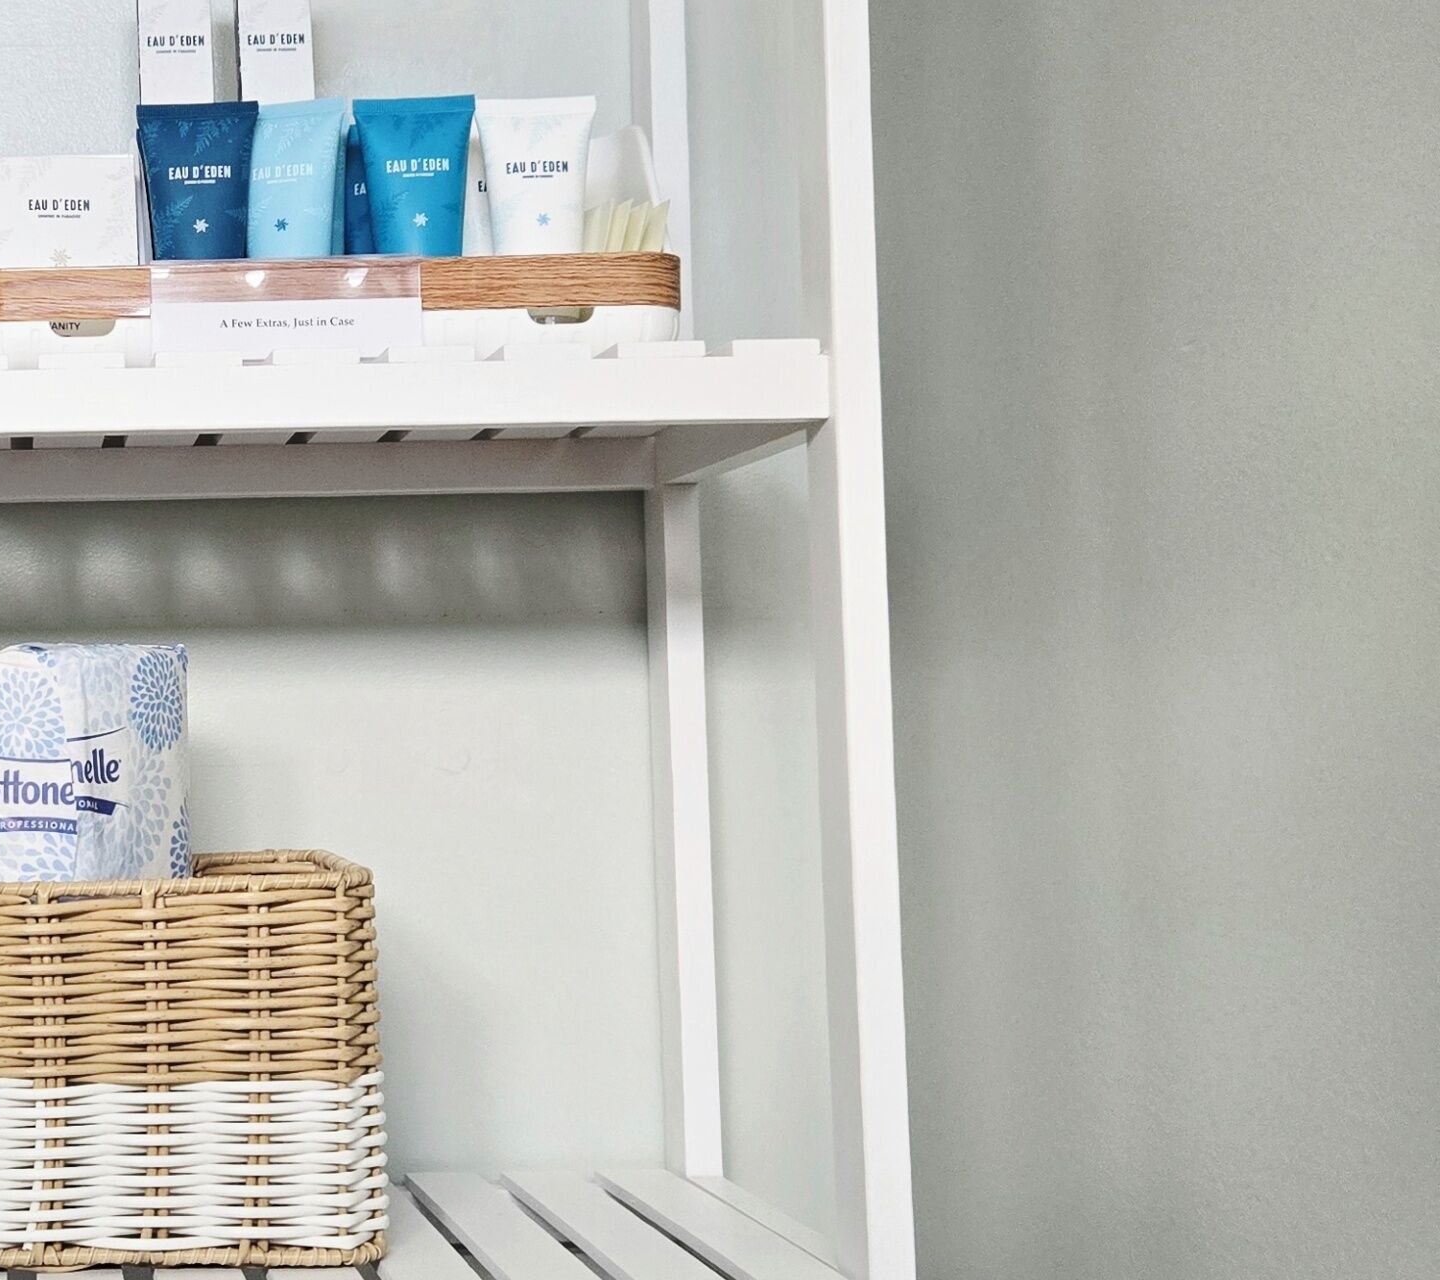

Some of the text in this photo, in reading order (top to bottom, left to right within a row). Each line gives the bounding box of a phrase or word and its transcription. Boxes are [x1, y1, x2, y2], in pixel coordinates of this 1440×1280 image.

[147, 35, 165, 47] EAU
[247, 34, 266, 46] EAU
[386, 159, 407, 173] EAU
[506, 162, 526, 174] EAU
[168, 166, 189, 180] EAU
[252, 167, 271, 181] EAU
[354, 183, 366, 195] EA
[28, 199, 48, 211] EAU
[219, 316, 355, 329] A Few Extras, Just in Case
